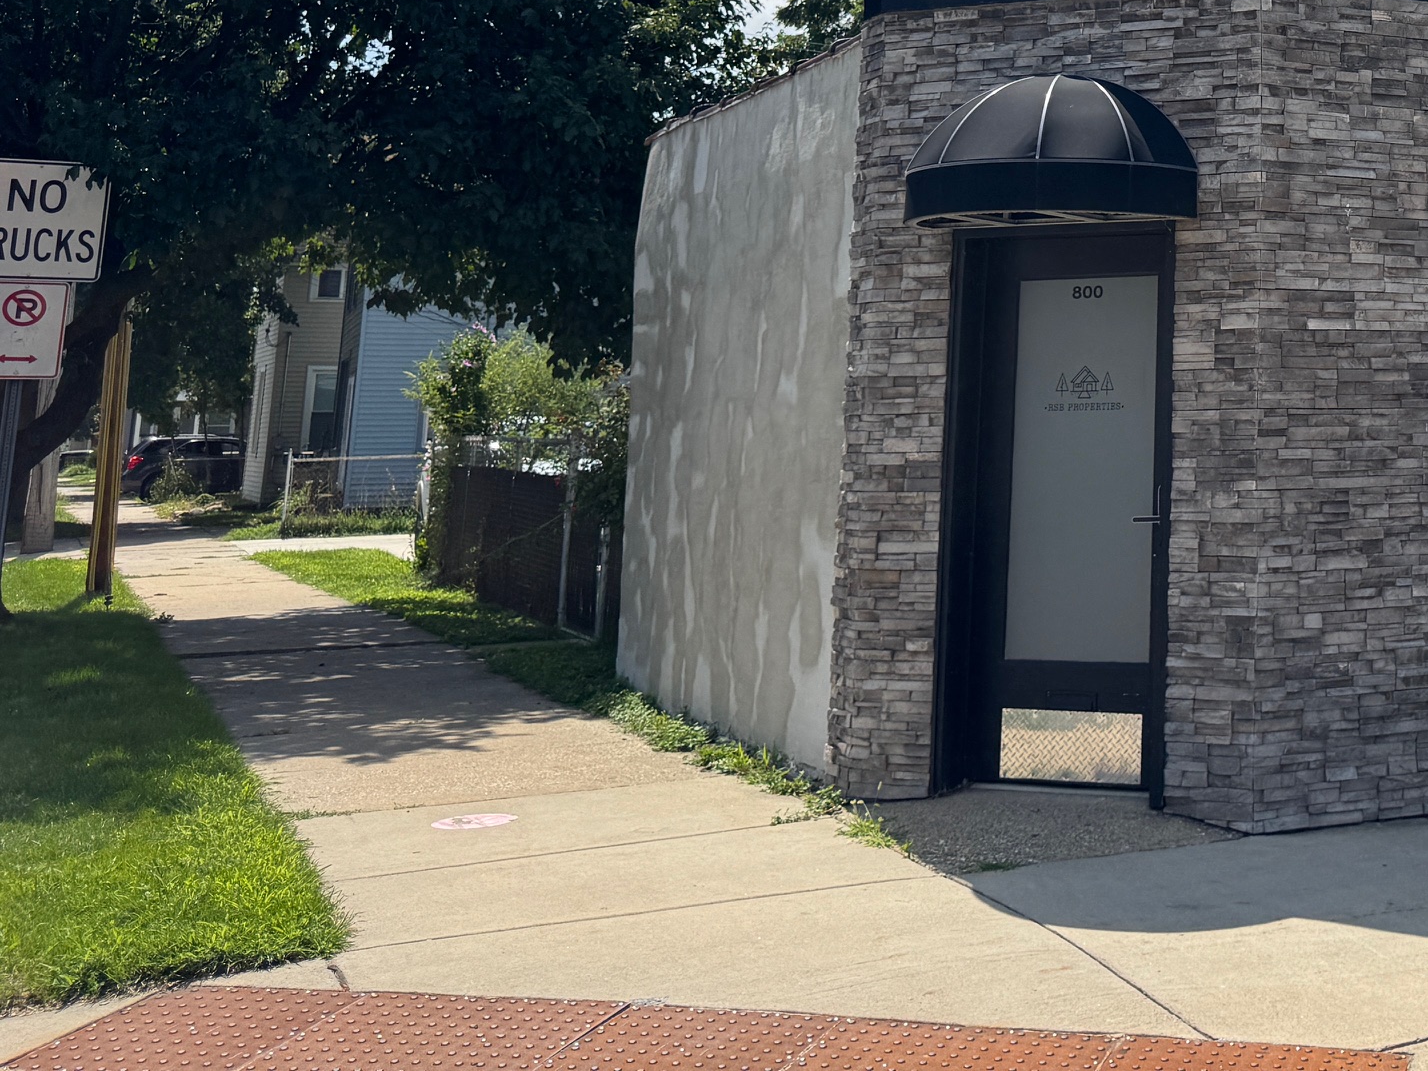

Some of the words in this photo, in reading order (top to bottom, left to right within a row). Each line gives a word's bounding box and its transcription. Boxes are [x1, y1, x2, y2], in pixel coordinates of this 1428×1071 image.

[7, 178, 67, 214] NO
[1072, 285, 1104, 300] 800
[1067, 402, 1121, 412] PROPERTIES
